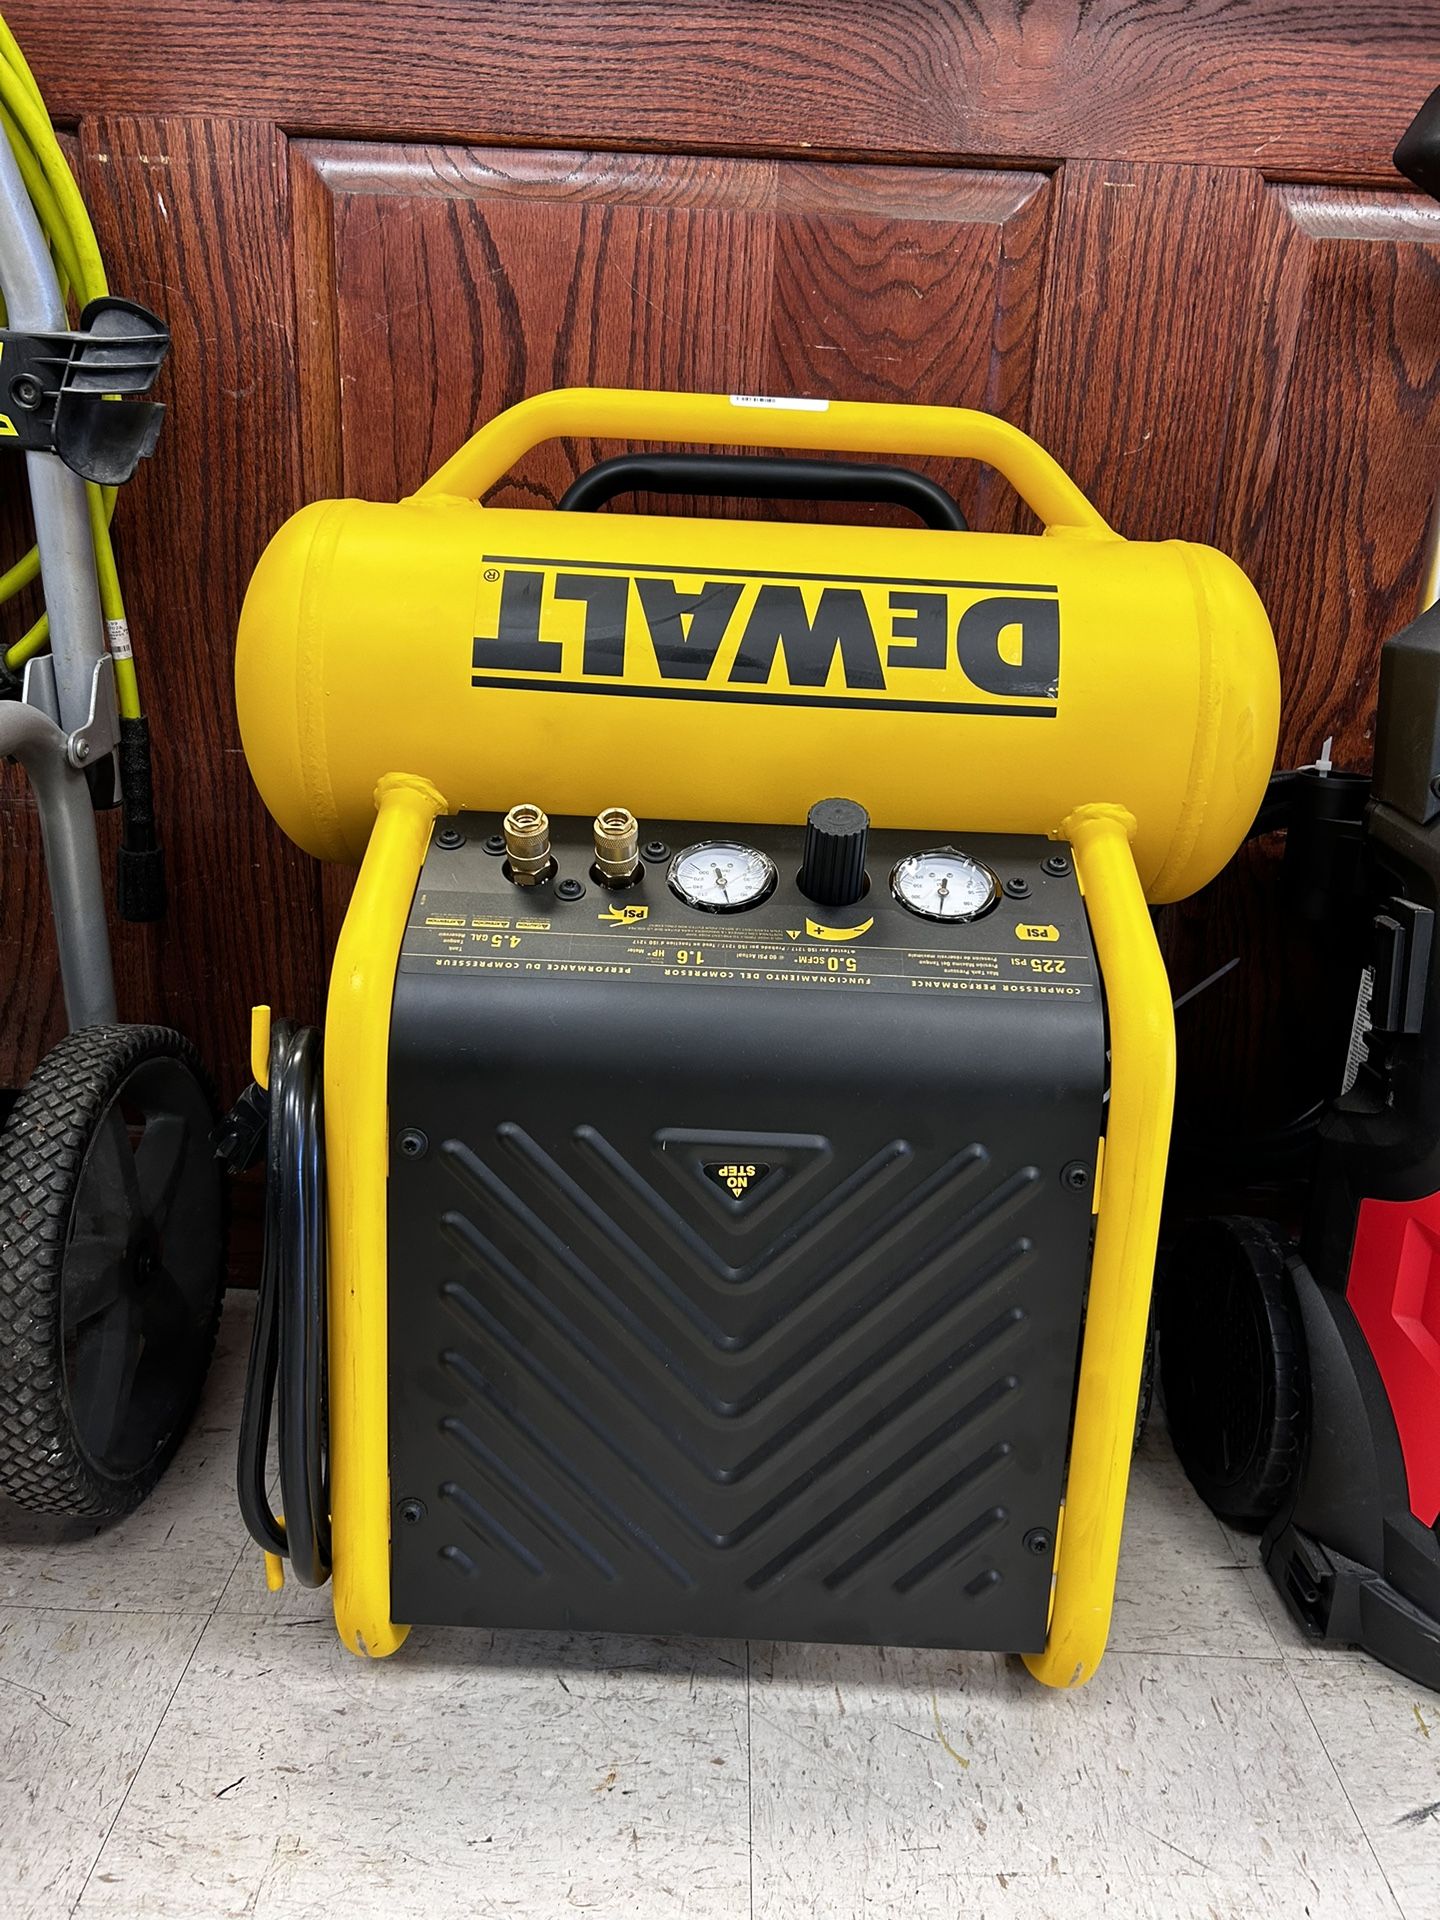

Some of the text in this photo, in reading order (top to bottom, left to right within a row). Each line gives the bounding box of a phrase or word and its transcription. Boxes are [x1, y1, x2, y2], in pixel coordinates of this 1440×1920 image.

[472, 570, 1059, 699] DEWALT
[624, 910, 644, 918] PSI
[1027, 929, 1048, 937] PSI
[470, 934, 521, 948] 4.5 GAL
[677, 950, 704, 965] 1.6
[435, 959, 519, 968] COMPRESSEUR
[547, 964, 631, 974] PERFORMANCE
[828, 957, 857, 971] 5.0
[1011, 958, 1066, 973] 225 PSI
[664, 969, 734, 978] COMPRESOR
[766, 974, 870, 984] FUNCIONAMIENTO
[911, 981, 1080, 994] COMPRESSOR PERFORMANCE
[718, 1165, 755, 1176] STEP
[726, 1177, 748, 1188] NO
